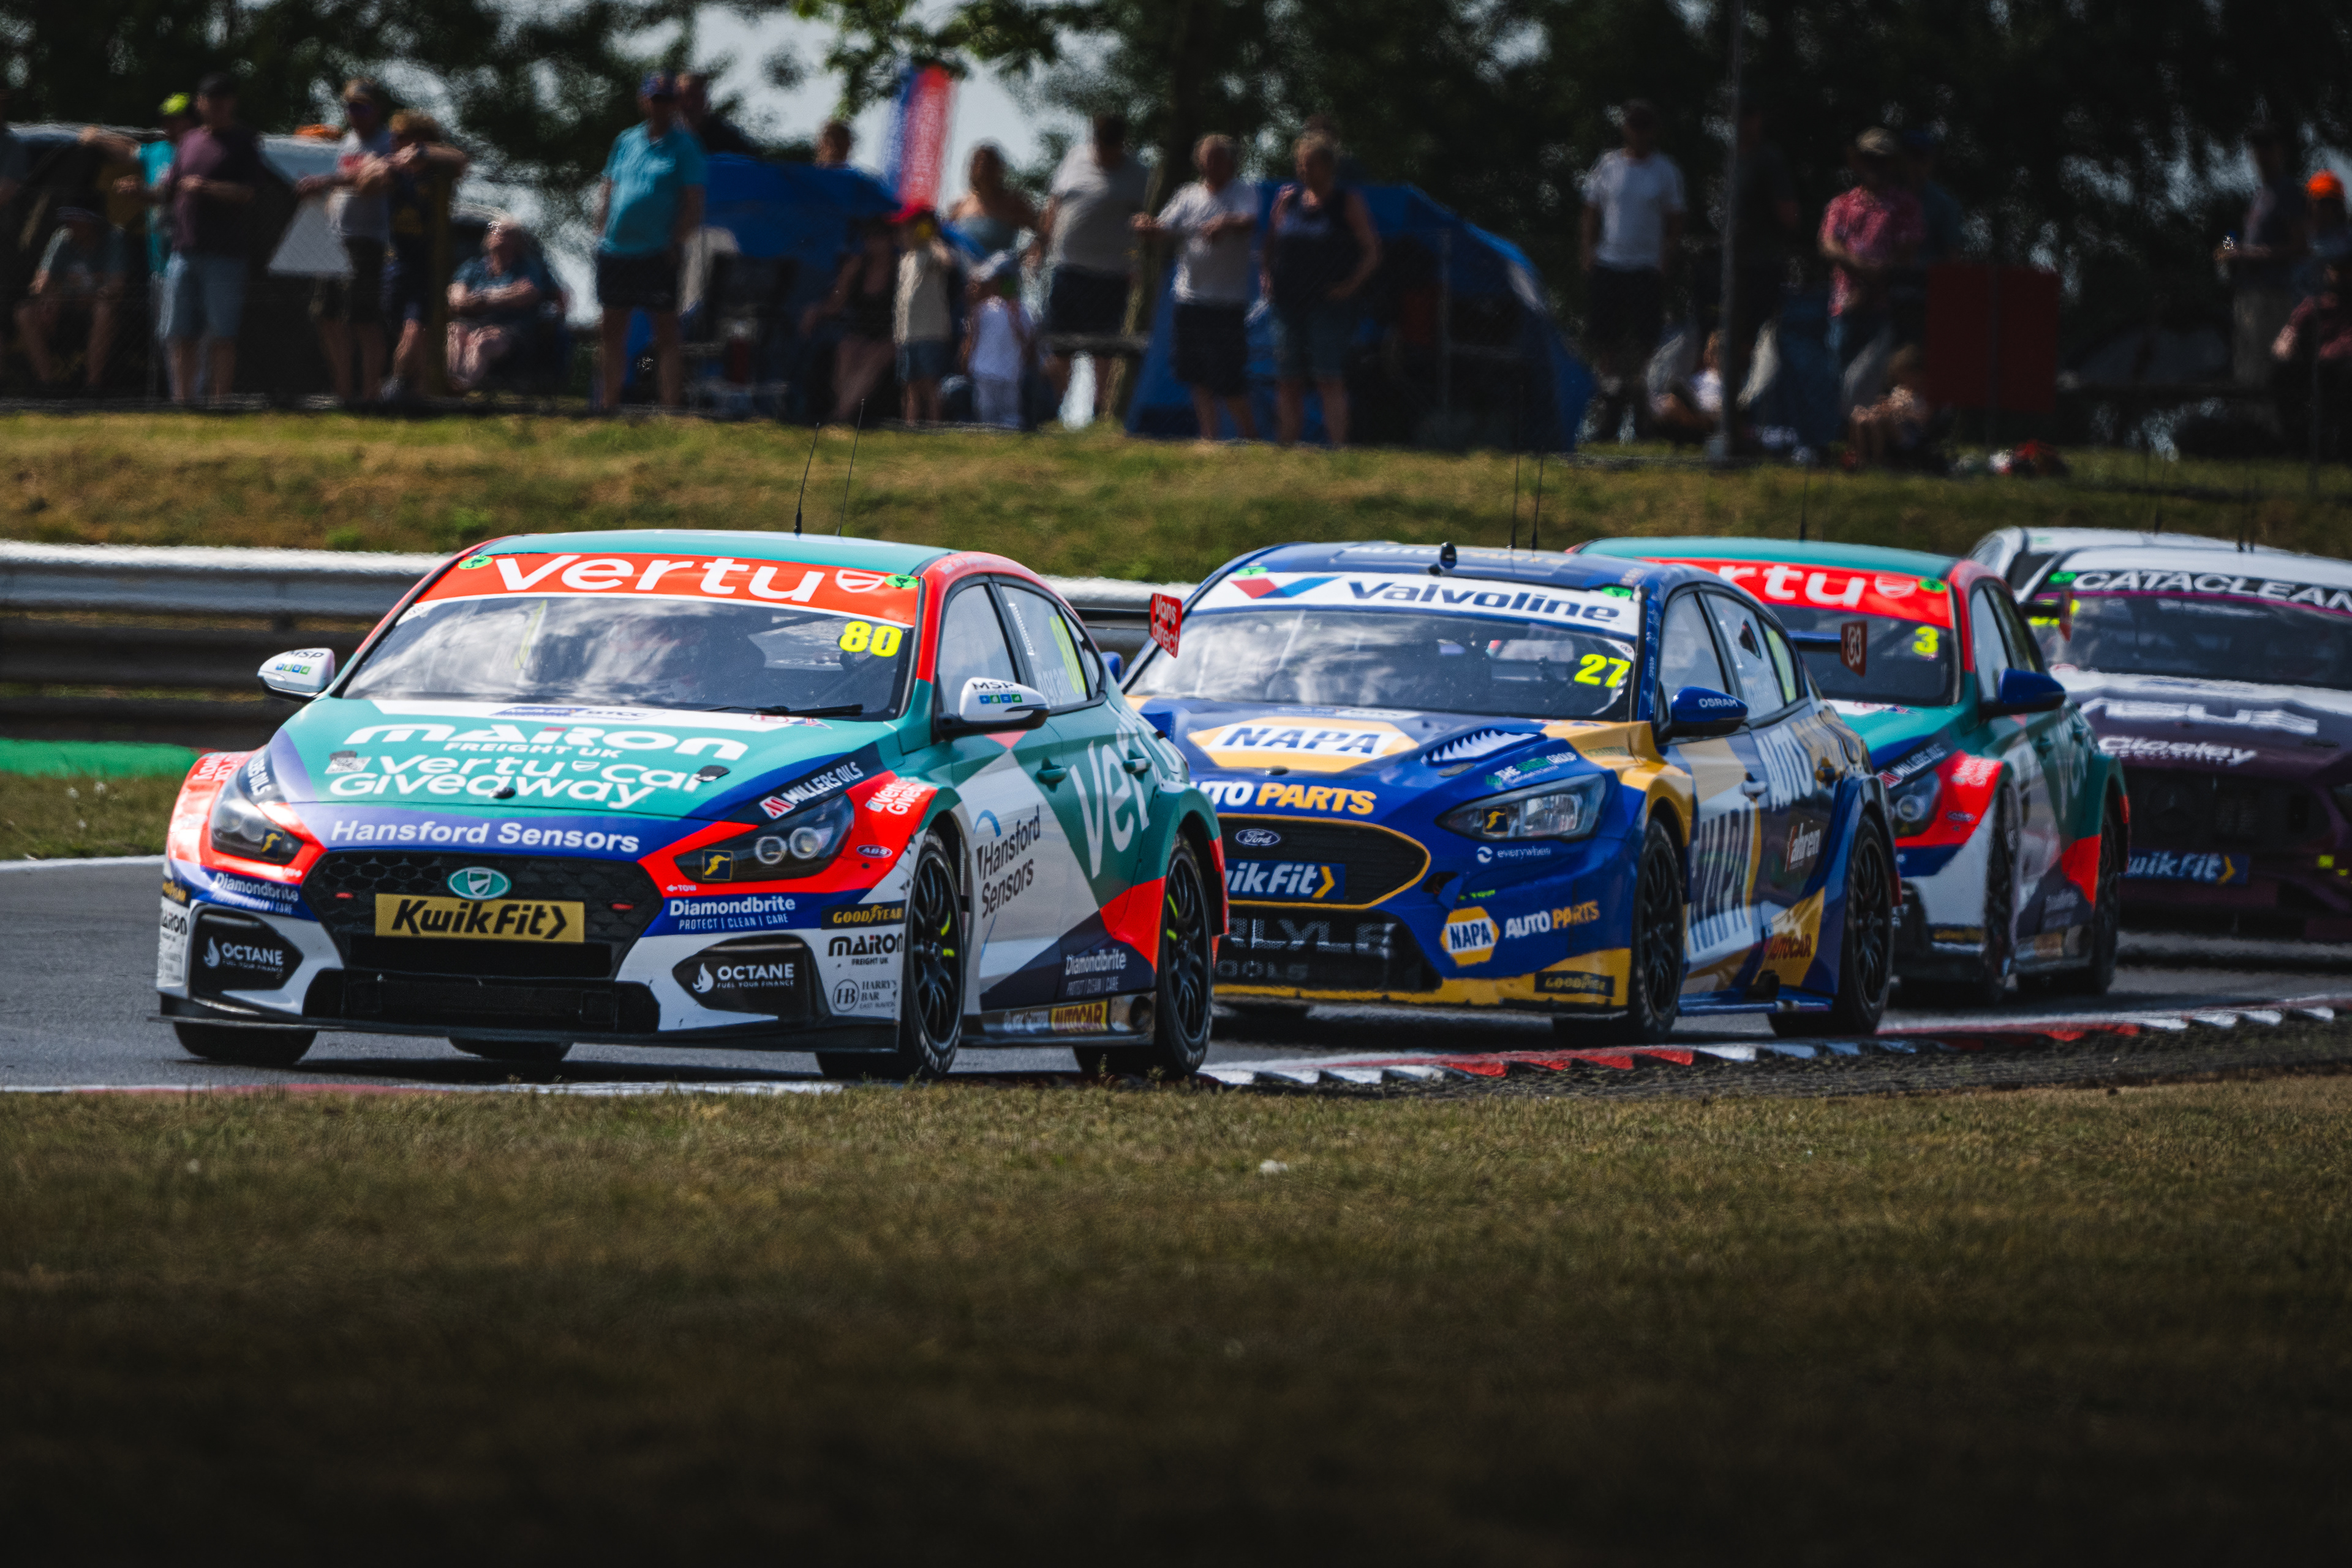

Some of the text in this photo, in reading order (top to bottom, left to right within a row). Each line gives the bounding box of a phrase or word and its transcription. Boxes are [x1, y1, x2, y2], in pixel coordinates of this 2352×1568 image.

[495, 554, 825, 603] Vertu
[1719, 565, 1866, 608] rtu
[1155, 594, 1176, 625] Vans
[1348, 581, 1620, 623] Valvoline
[840, 620, 902, 657] 80
[1912, 626, 1939, 657] 3
[1574, 654, 1631, 688] 27
[1698, 698, 1738, 708] OSRAM
[443, 742, 624, 758] FREIGHT UK
[1221, 727, 1382, 755] NAPA
[380, 754, 565, 778] Vertu
[1546, 752, 1577, 764] GROUP
[330, 772, 656, 810] Giveaway
[781, 761, 864, 805] MILLERS OILS
[1256, 782, 1378, 815] PARTS
[331, 820, 639, 853] Hansford Sensors
[983, 804, 1041, 881] Hansford
[1243, 830, 1273, 844] Ford
[215, 872, 299, 902] Diamondbrite
[982, 858, 1034, 919] Sensors
[1226, 862, 1318, 895] ikFit
[669, 895, 796, 916] Diamondbrite
[833, 905, 903, 924] GOODYEAR
[1504, 899, 1600, 939] AUTO PARTS
[679, 913, 789, 930] PROTECT CLEAN CARE
[1449, 920, 1493, 950] NAPA
[221, 942, 284, 966] OCTANE
[851, 957, 878, 966] FREIGHT
[1065, 949, 1127, 976] Diamondbrite
[717, 963, 795, 980] OCTANE
[1217, 959, 1309, 980] OOLS
[861, 992, 880, 1001] BAR
[1054, 1003, 1104, 1030] AUTOCAR
